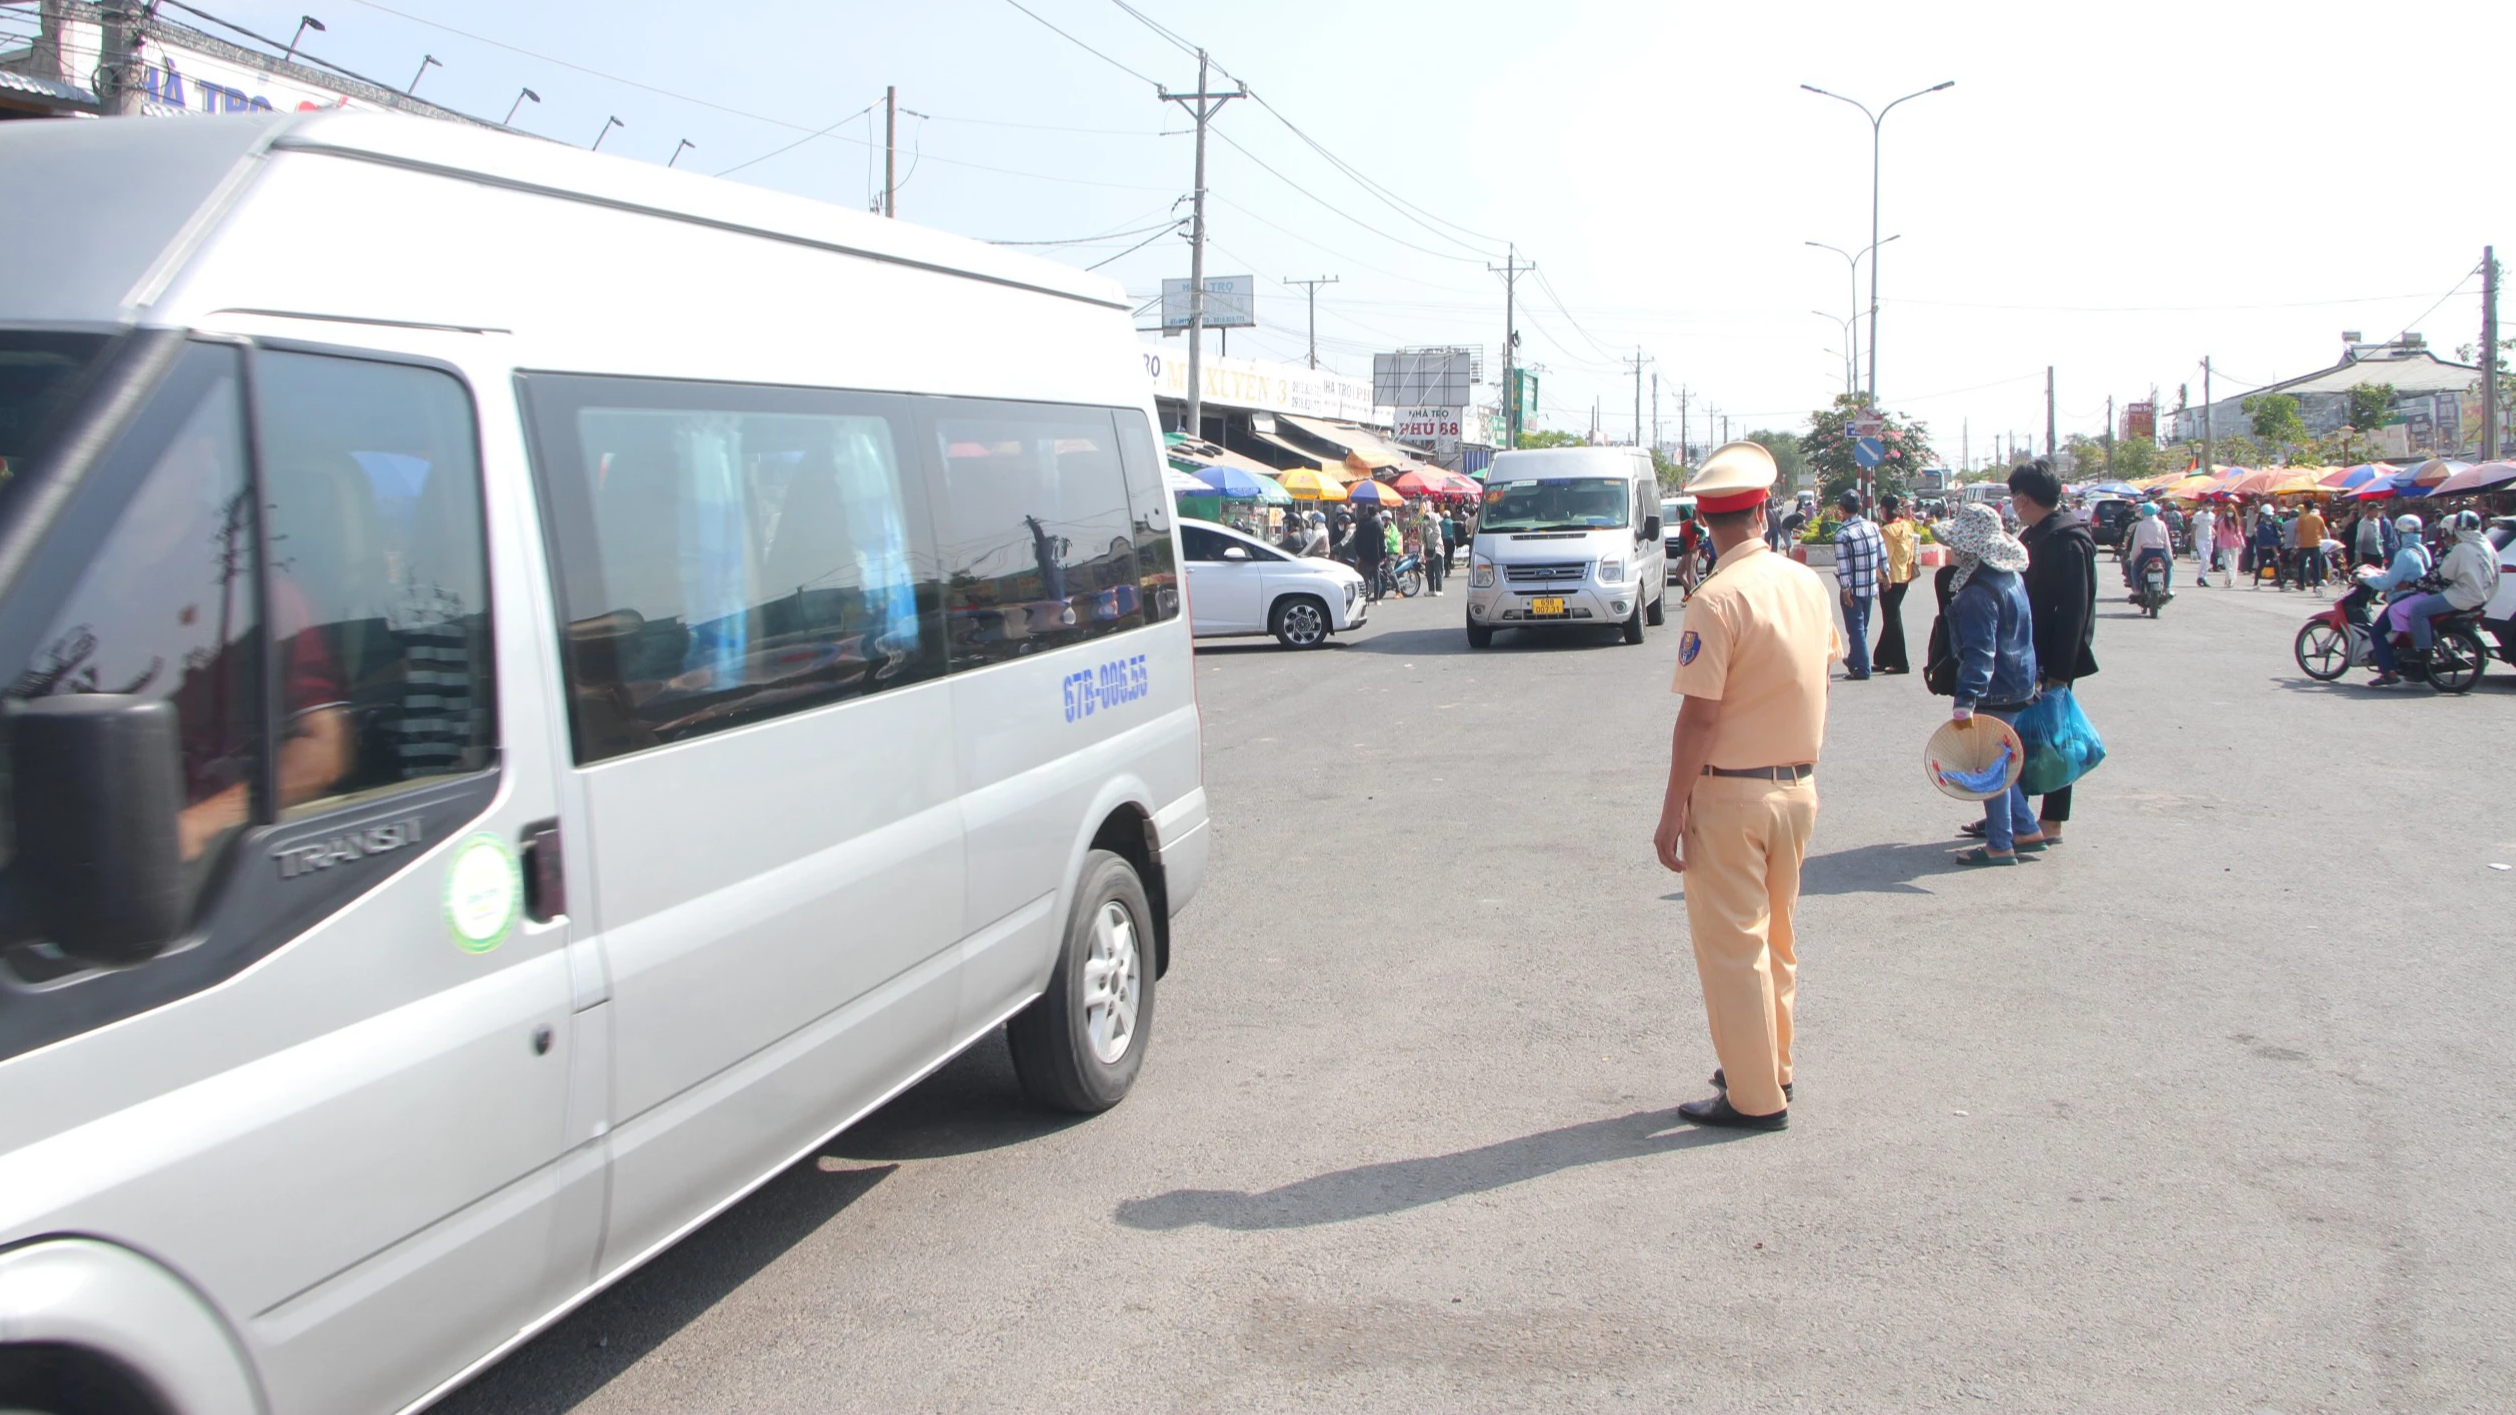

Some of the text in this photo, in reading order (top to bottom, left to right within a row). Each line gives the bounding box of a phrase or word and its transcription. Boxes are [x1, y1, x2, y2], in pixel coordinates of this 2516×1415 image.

[1277, 379, 1288, 405] 3
[1399, 418, 1459, 435] PHÚ 88
[1409, 408, 1449, 420] NHÀ TRỌ
[1063, 654, 1148, 723] 67B-006.55
[272, 816, 425, 880] TRANSIT
